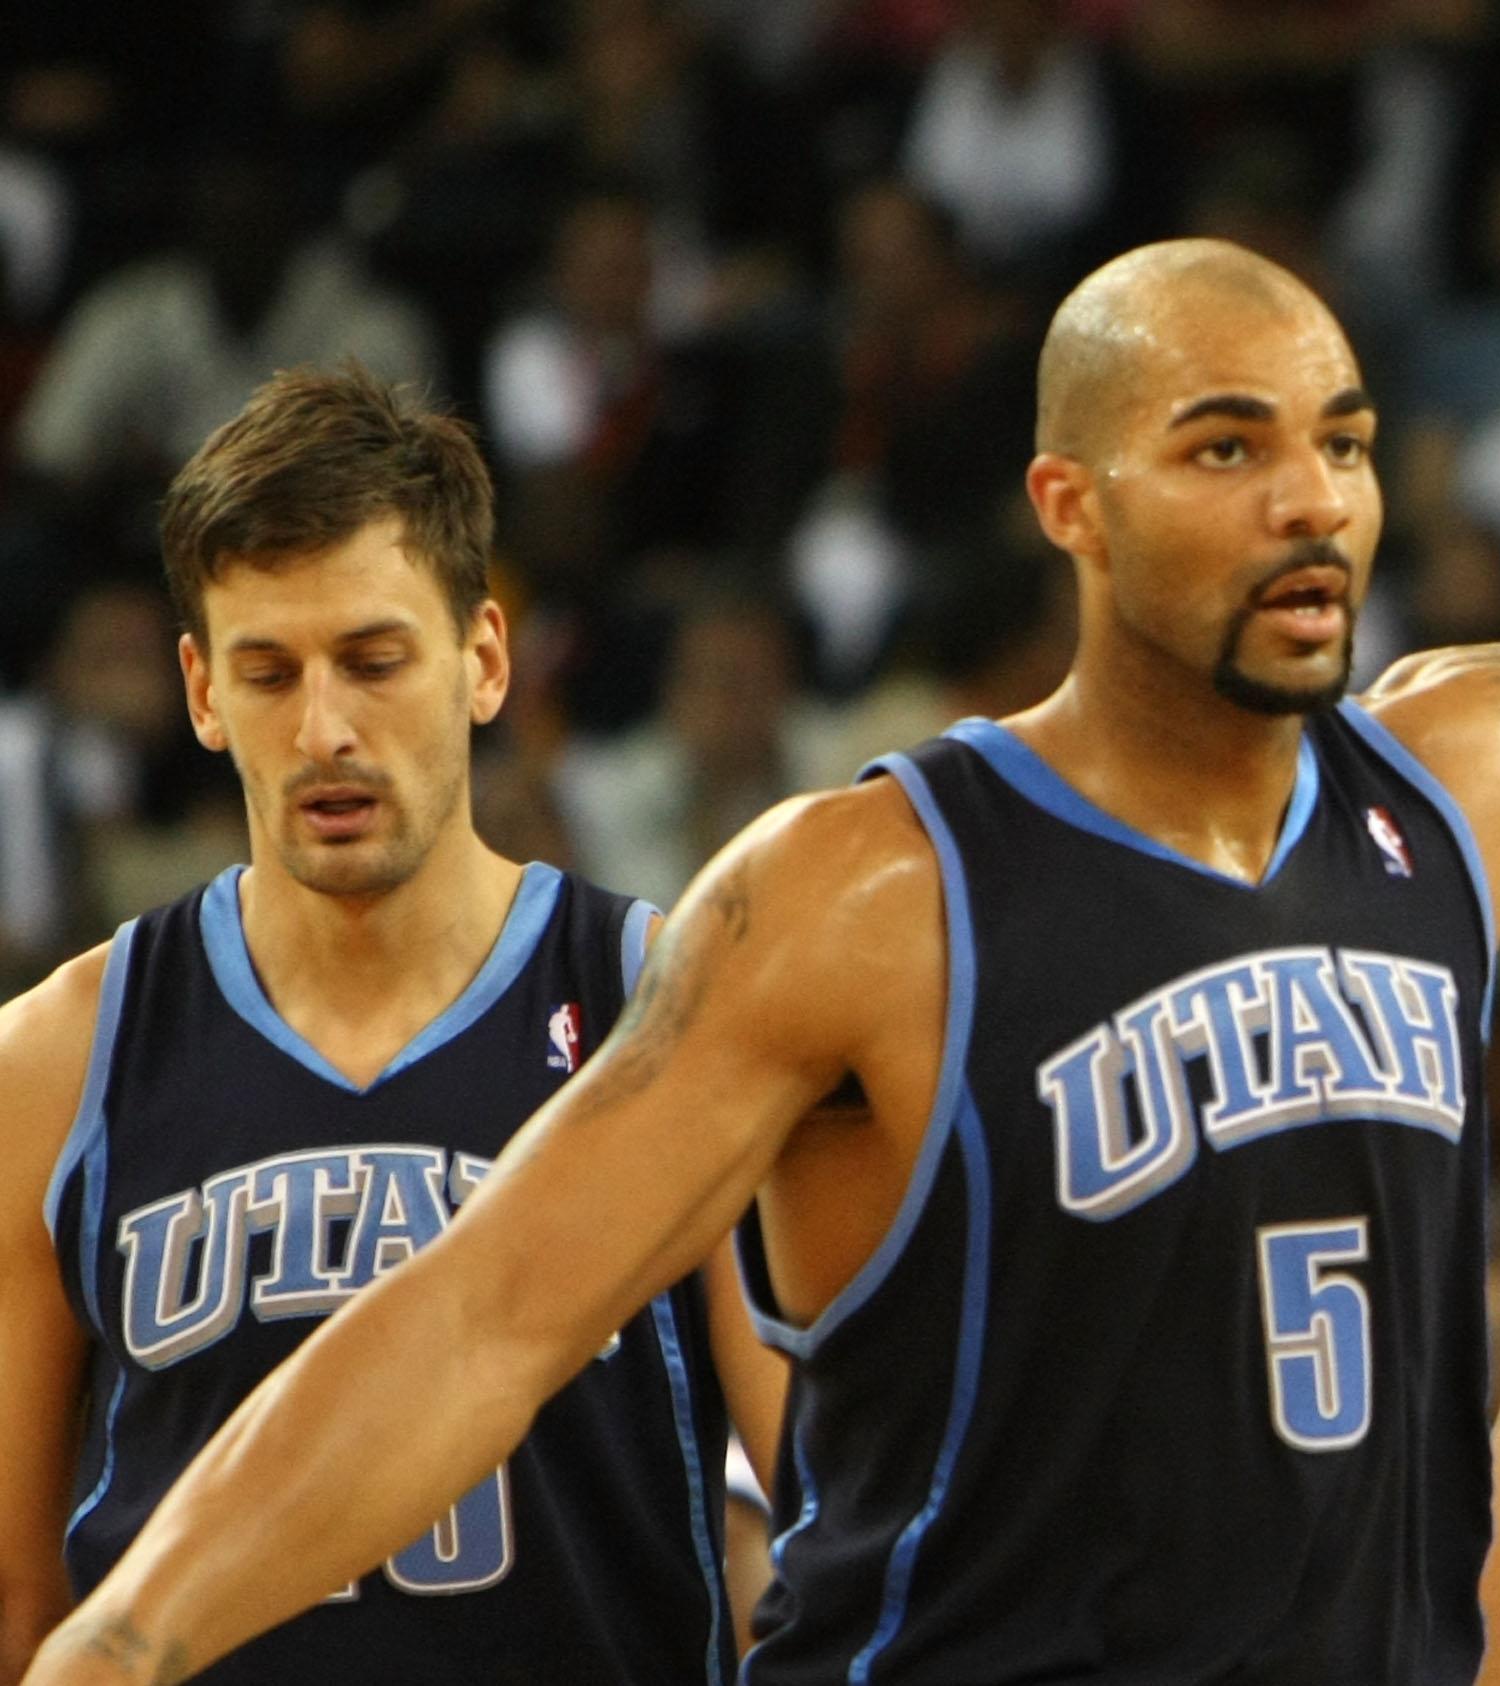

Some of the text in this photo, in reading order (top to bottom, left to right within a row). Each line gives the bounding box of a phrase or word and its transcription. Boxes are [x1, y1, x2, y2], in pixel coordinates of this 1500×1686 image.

[1036, 944, 1466, 1223] UTAH
[117, 1143, 496, 1372] UTA
[1256, 1216, 1373, 1452] 5
